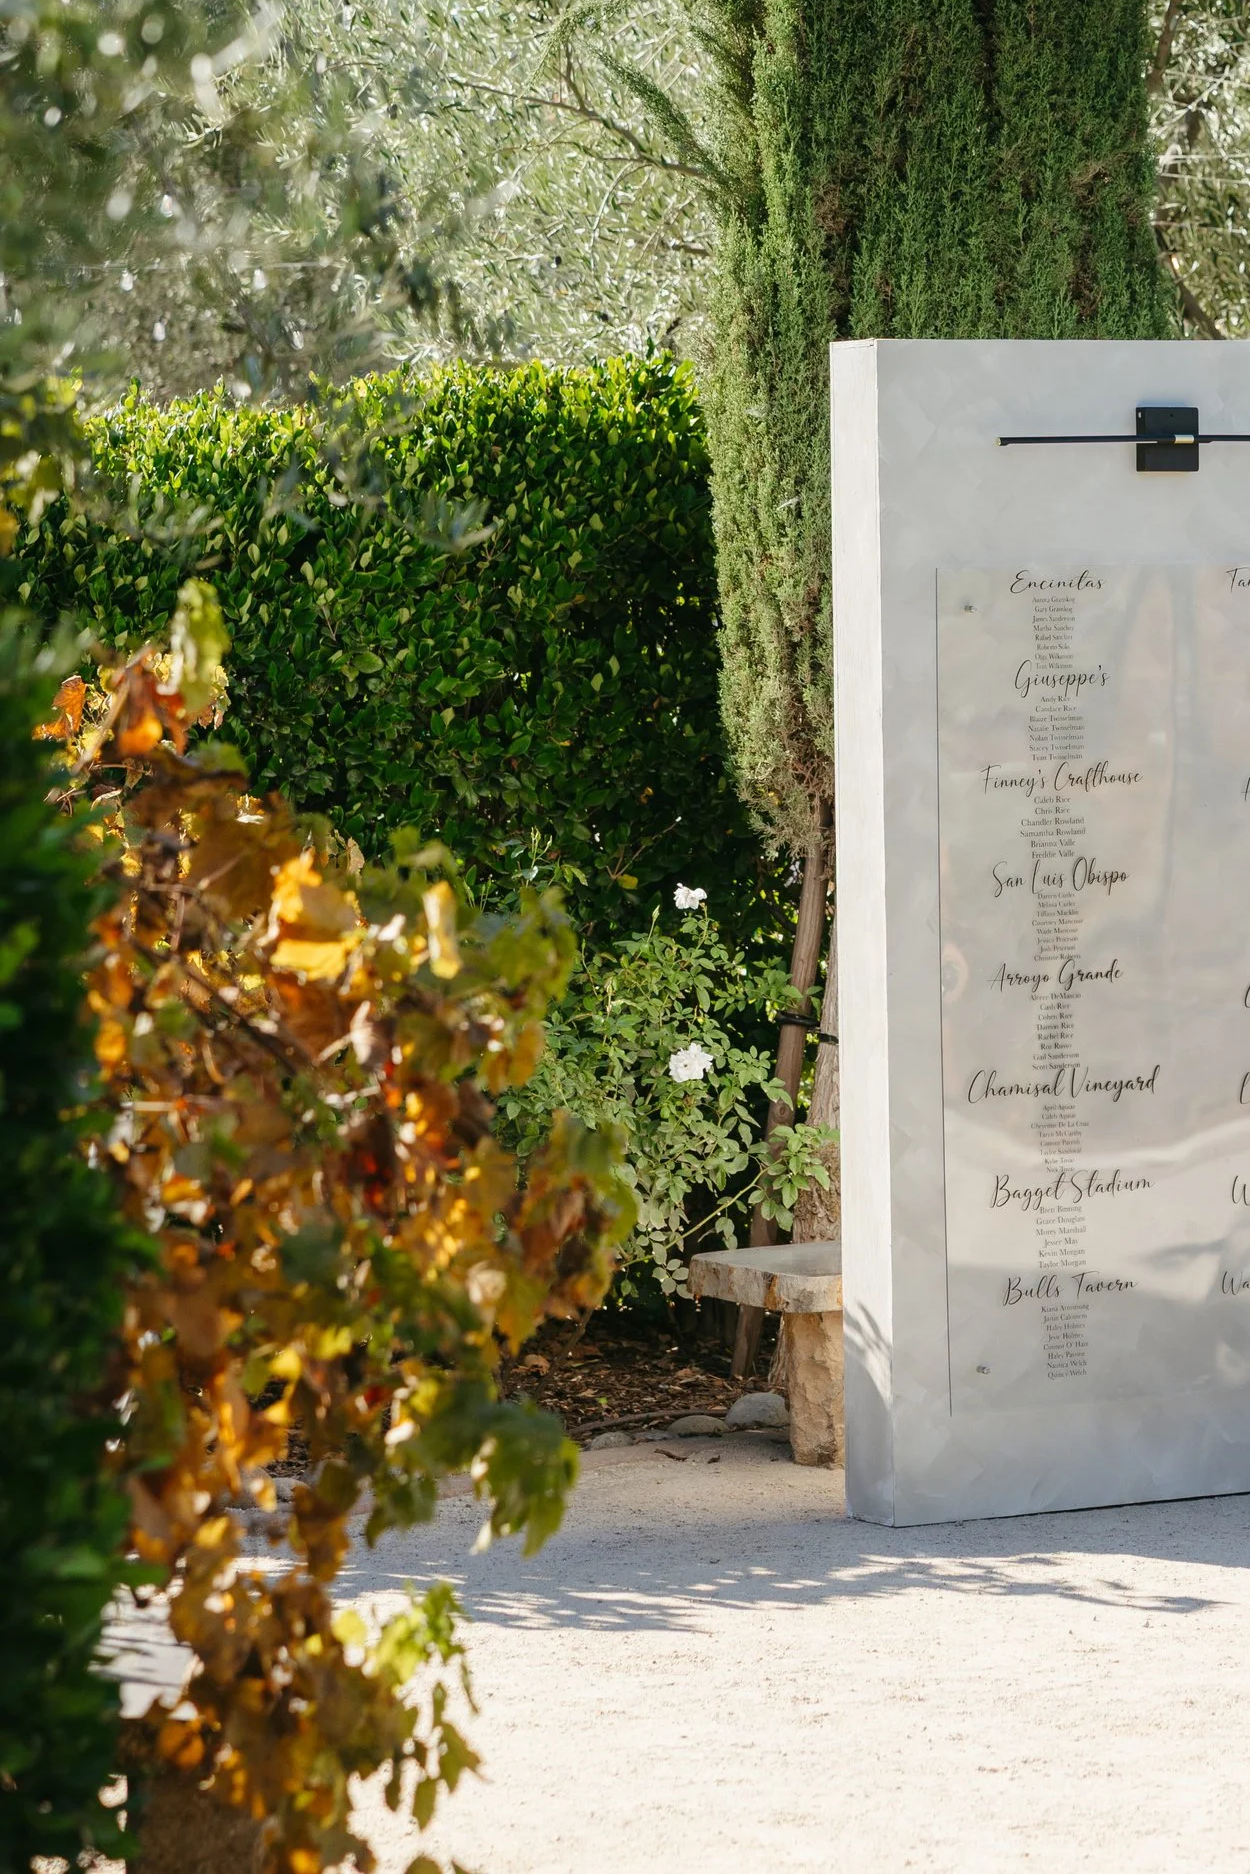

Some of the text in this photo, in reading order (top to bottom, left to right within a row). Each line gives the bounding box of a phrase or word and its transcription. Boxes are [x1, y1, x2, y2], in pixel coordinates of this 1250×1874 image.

[1010, 570, 1105, 594] Encinitas
[1015, 660, 1110, 698] Giuseppe's
[982, 760, 1144, 798] Finney's Crafthouse
[992, 856, 1130, 898] San Luis Obispo
[987, 958, 1124, 992] Arroyo Grande
[968, 1065, 1160, 1104] Chamisal Vineyard
[990, 1170, 1155, 1212] Bagget Stadium
[1003, 1270, 1138, 1306] Bulls Tavern
